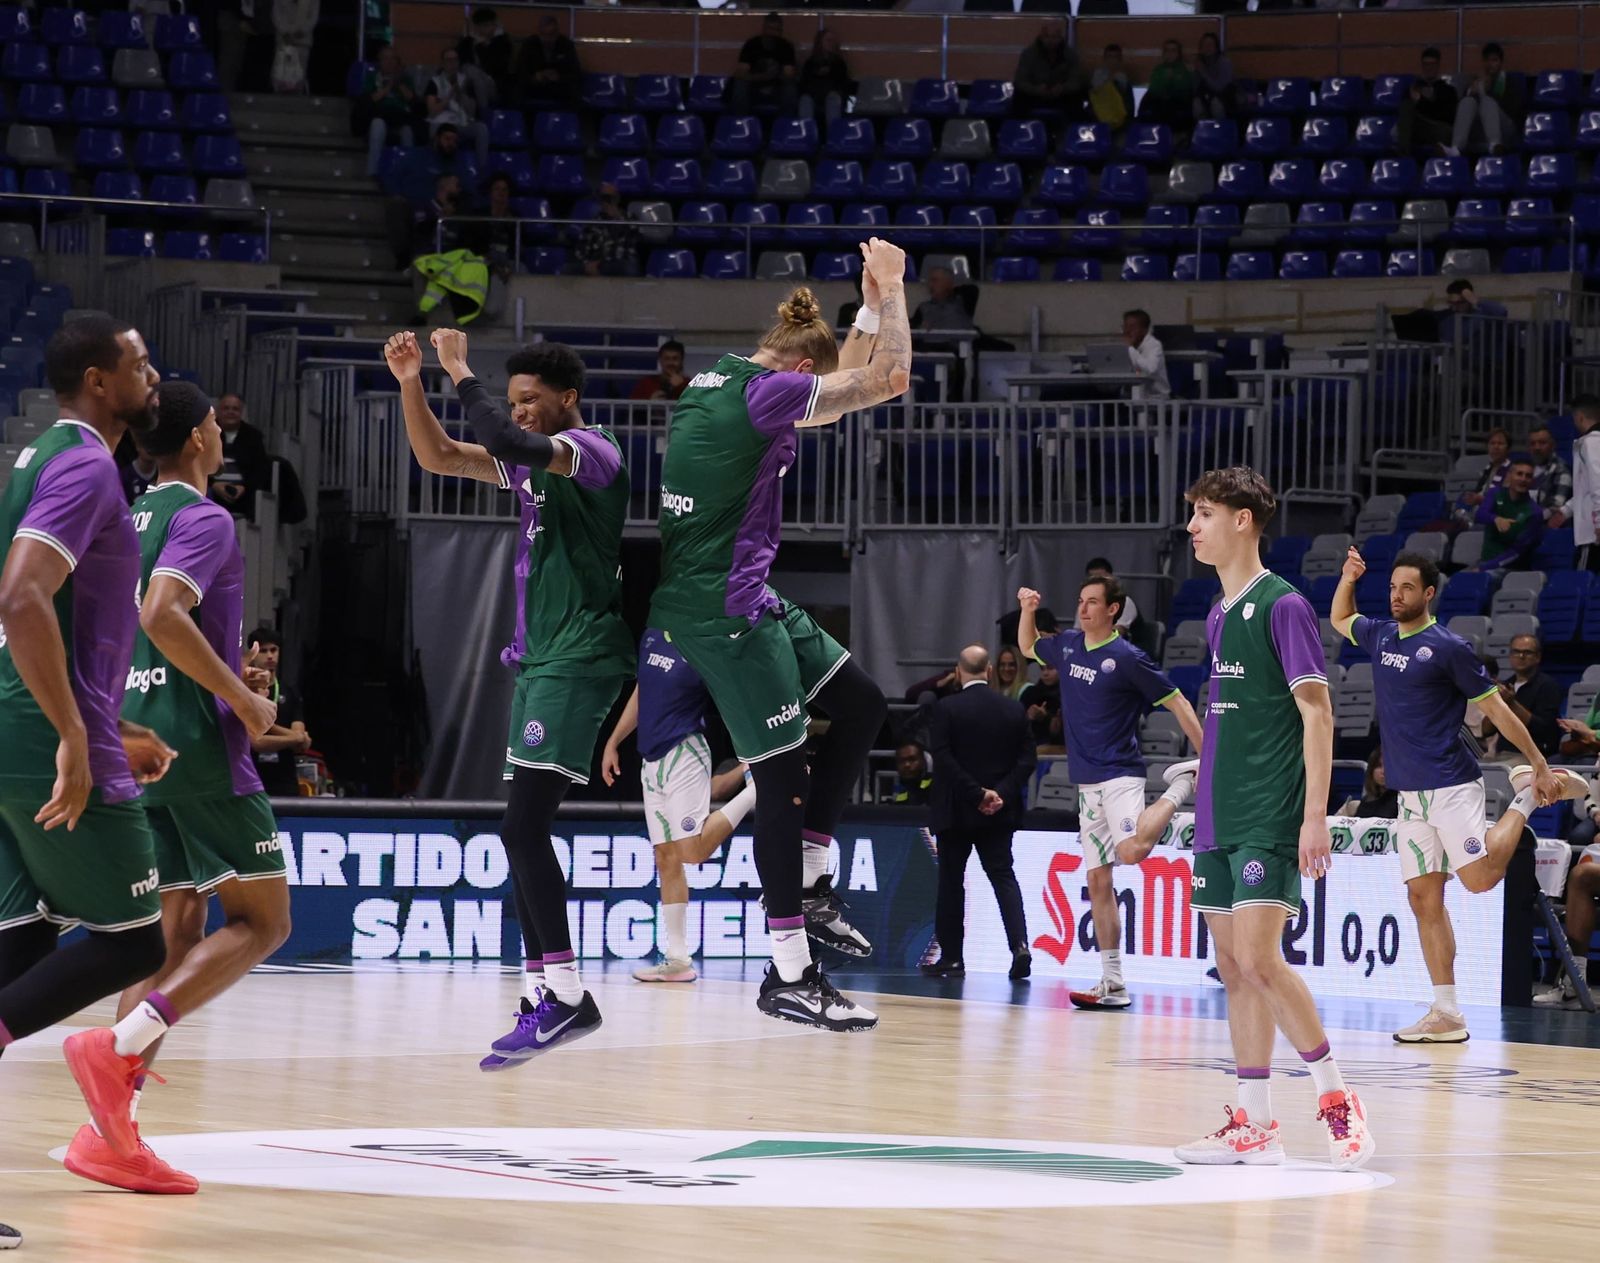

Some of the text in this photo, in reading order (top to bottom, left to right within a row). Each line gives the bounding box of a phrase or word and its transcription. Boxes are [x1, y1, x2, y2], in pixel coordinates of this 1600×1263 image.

[133, 511, 153, 532] OR
[646, 653, 676, 673] TOFAŞ
[1381, 651, 1410, 672] TOFAŞ
[1069, 663, 1098, 685] TOFAŞ
[766, 698, 801, 729] mála
[1330, 833, 1344, 851] 12
[1366, 832, 1385, 852] 33
[847, 838, 878, 892] A
[352, 898, 503, 959] SAN
[1341, 912, 1400, 978] 0,0
